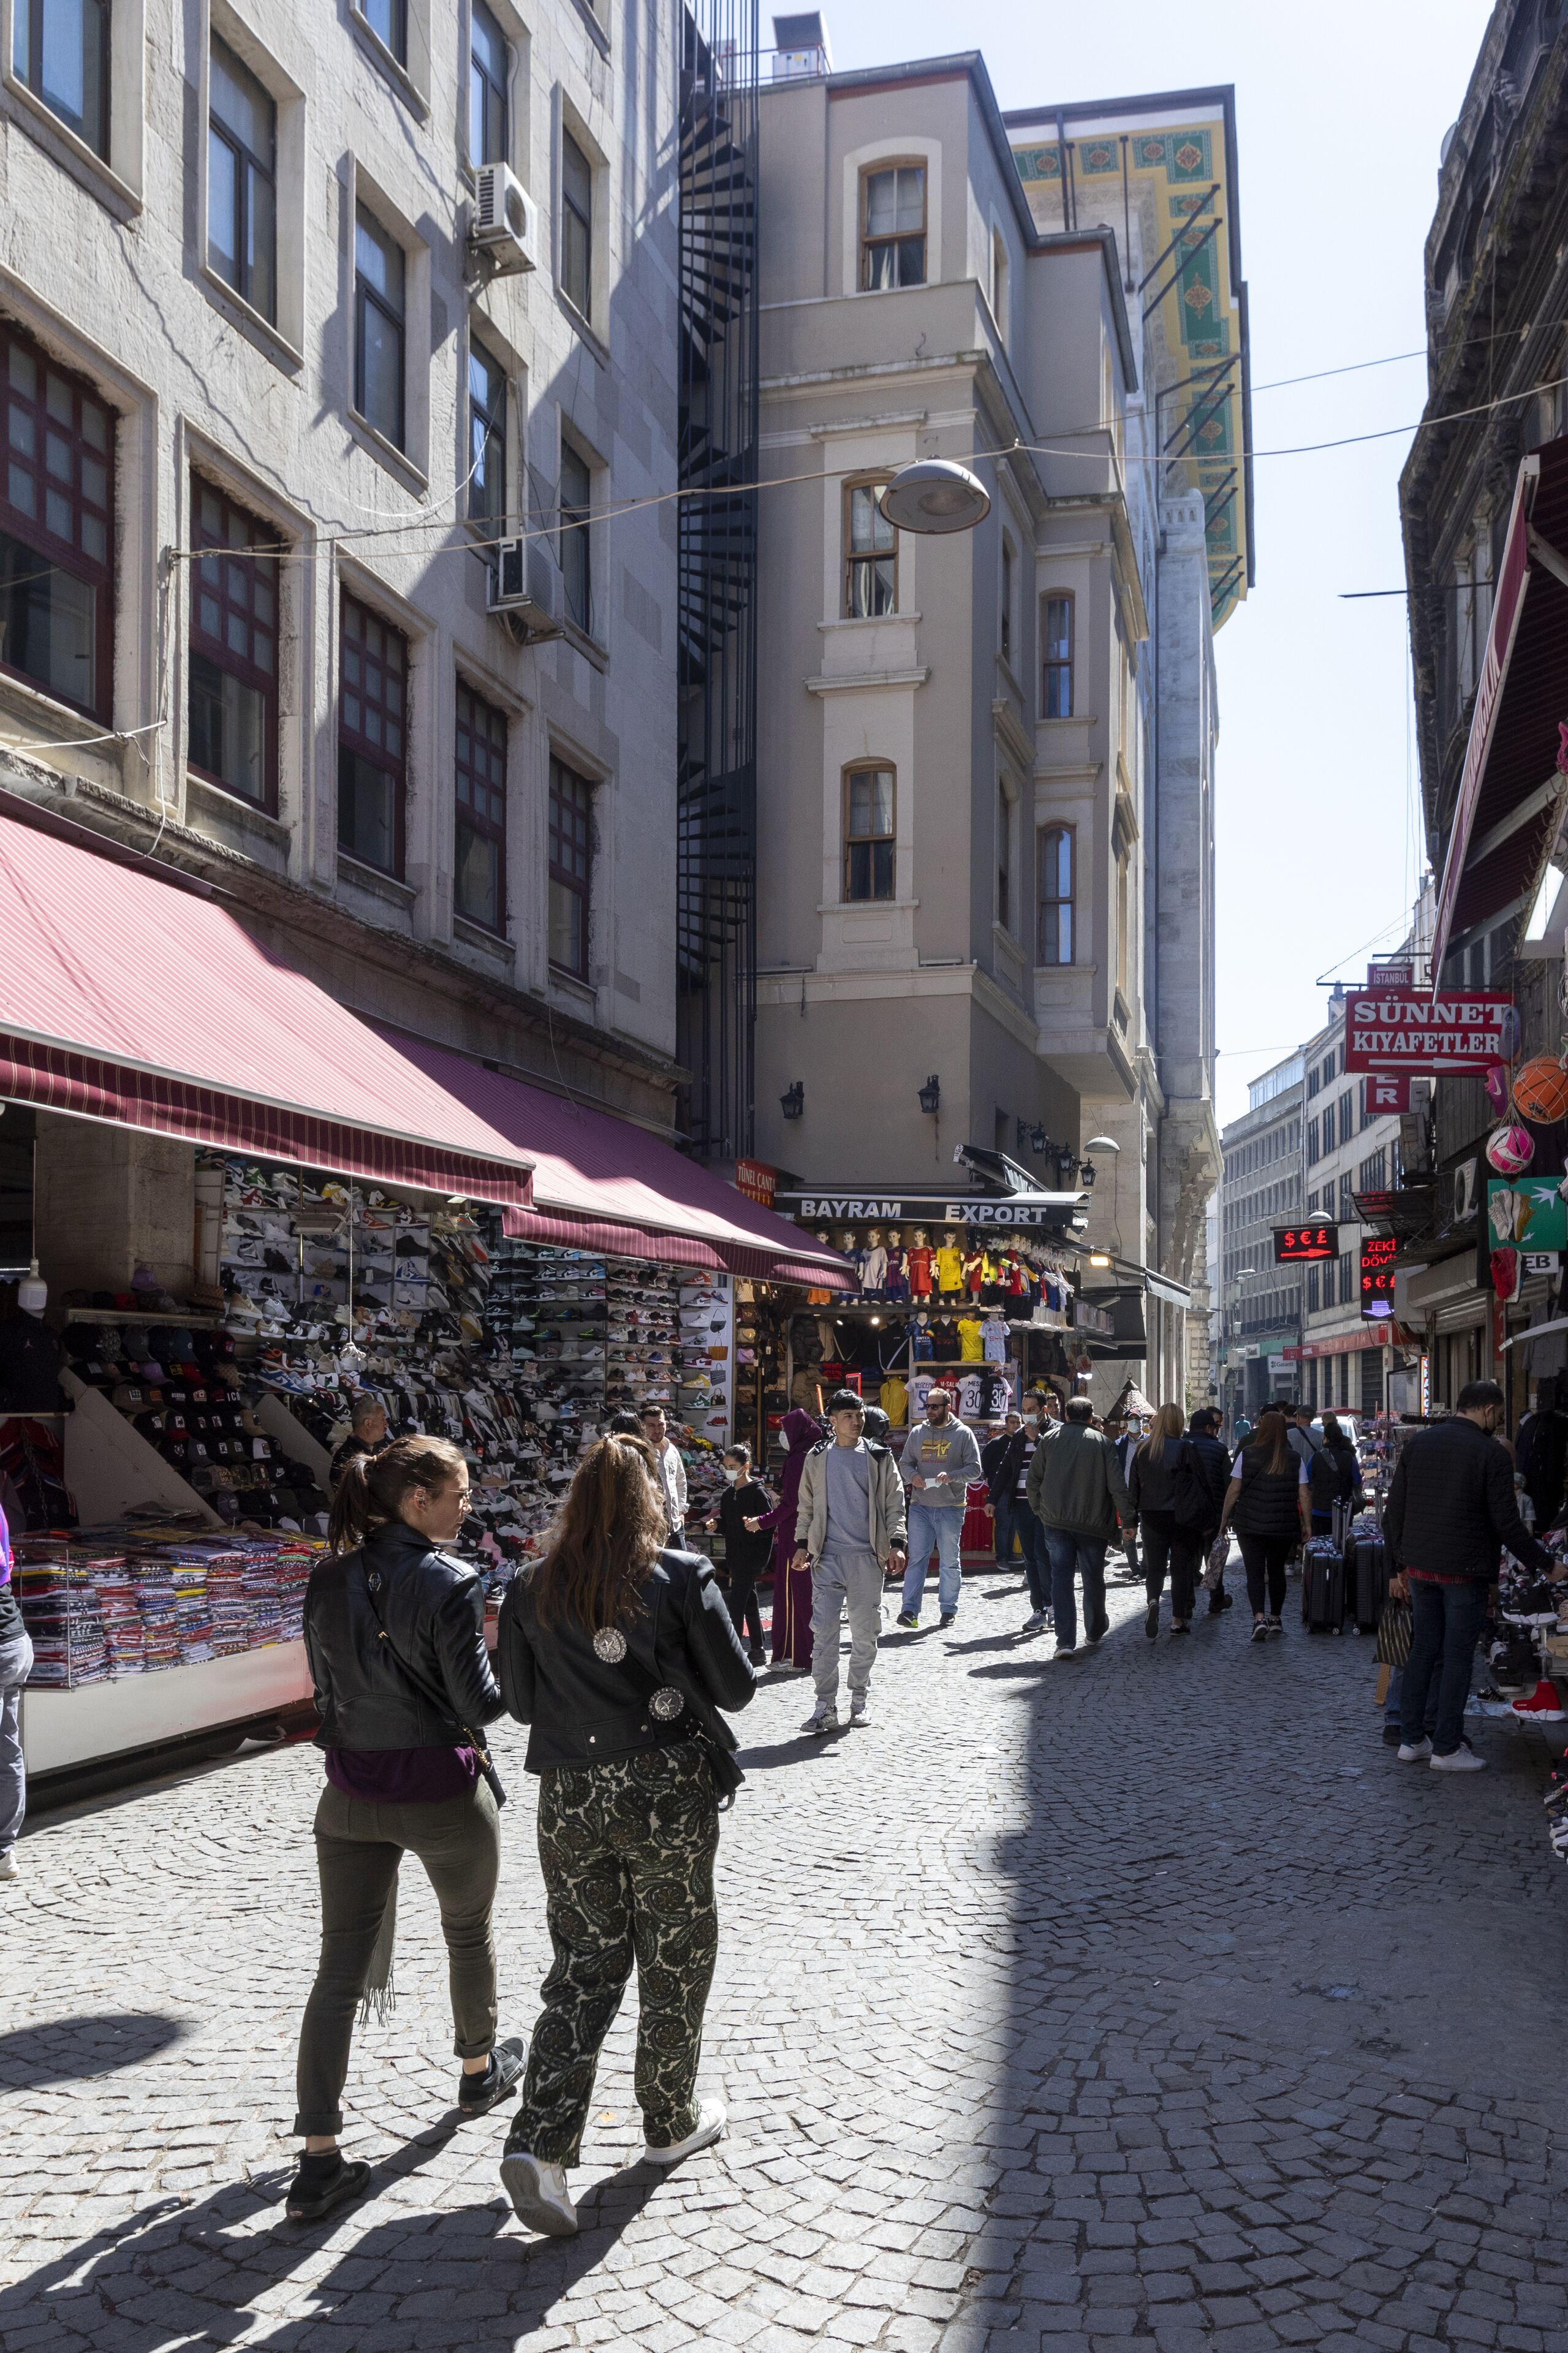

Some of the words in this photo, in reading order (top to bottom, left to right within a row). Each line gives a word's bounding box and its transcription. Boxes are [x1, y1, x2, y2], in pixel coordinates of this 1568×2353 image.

[1374, 971, 1409, 983] İSTANBUL
[1354, 995, 1510, 1025] SÜNNET
[1352, 1031, 1501, 1055] KIYAFETLER
[738, 1162, 756, 1186] TÜNEL
[757, 1172, 776, 1191] ÇANTA
[801, 1200, 901, 1218] BAYRAM
[945, 1205, 1047, 1223] EXPORT
[1367, 1238, 1396, 1252] ZEKİ
[1362, 1254, 1397, 1268] DÖV
[1524, 1255, 1551, 1269] EB
[966, 1390, 980, 1408] 30
